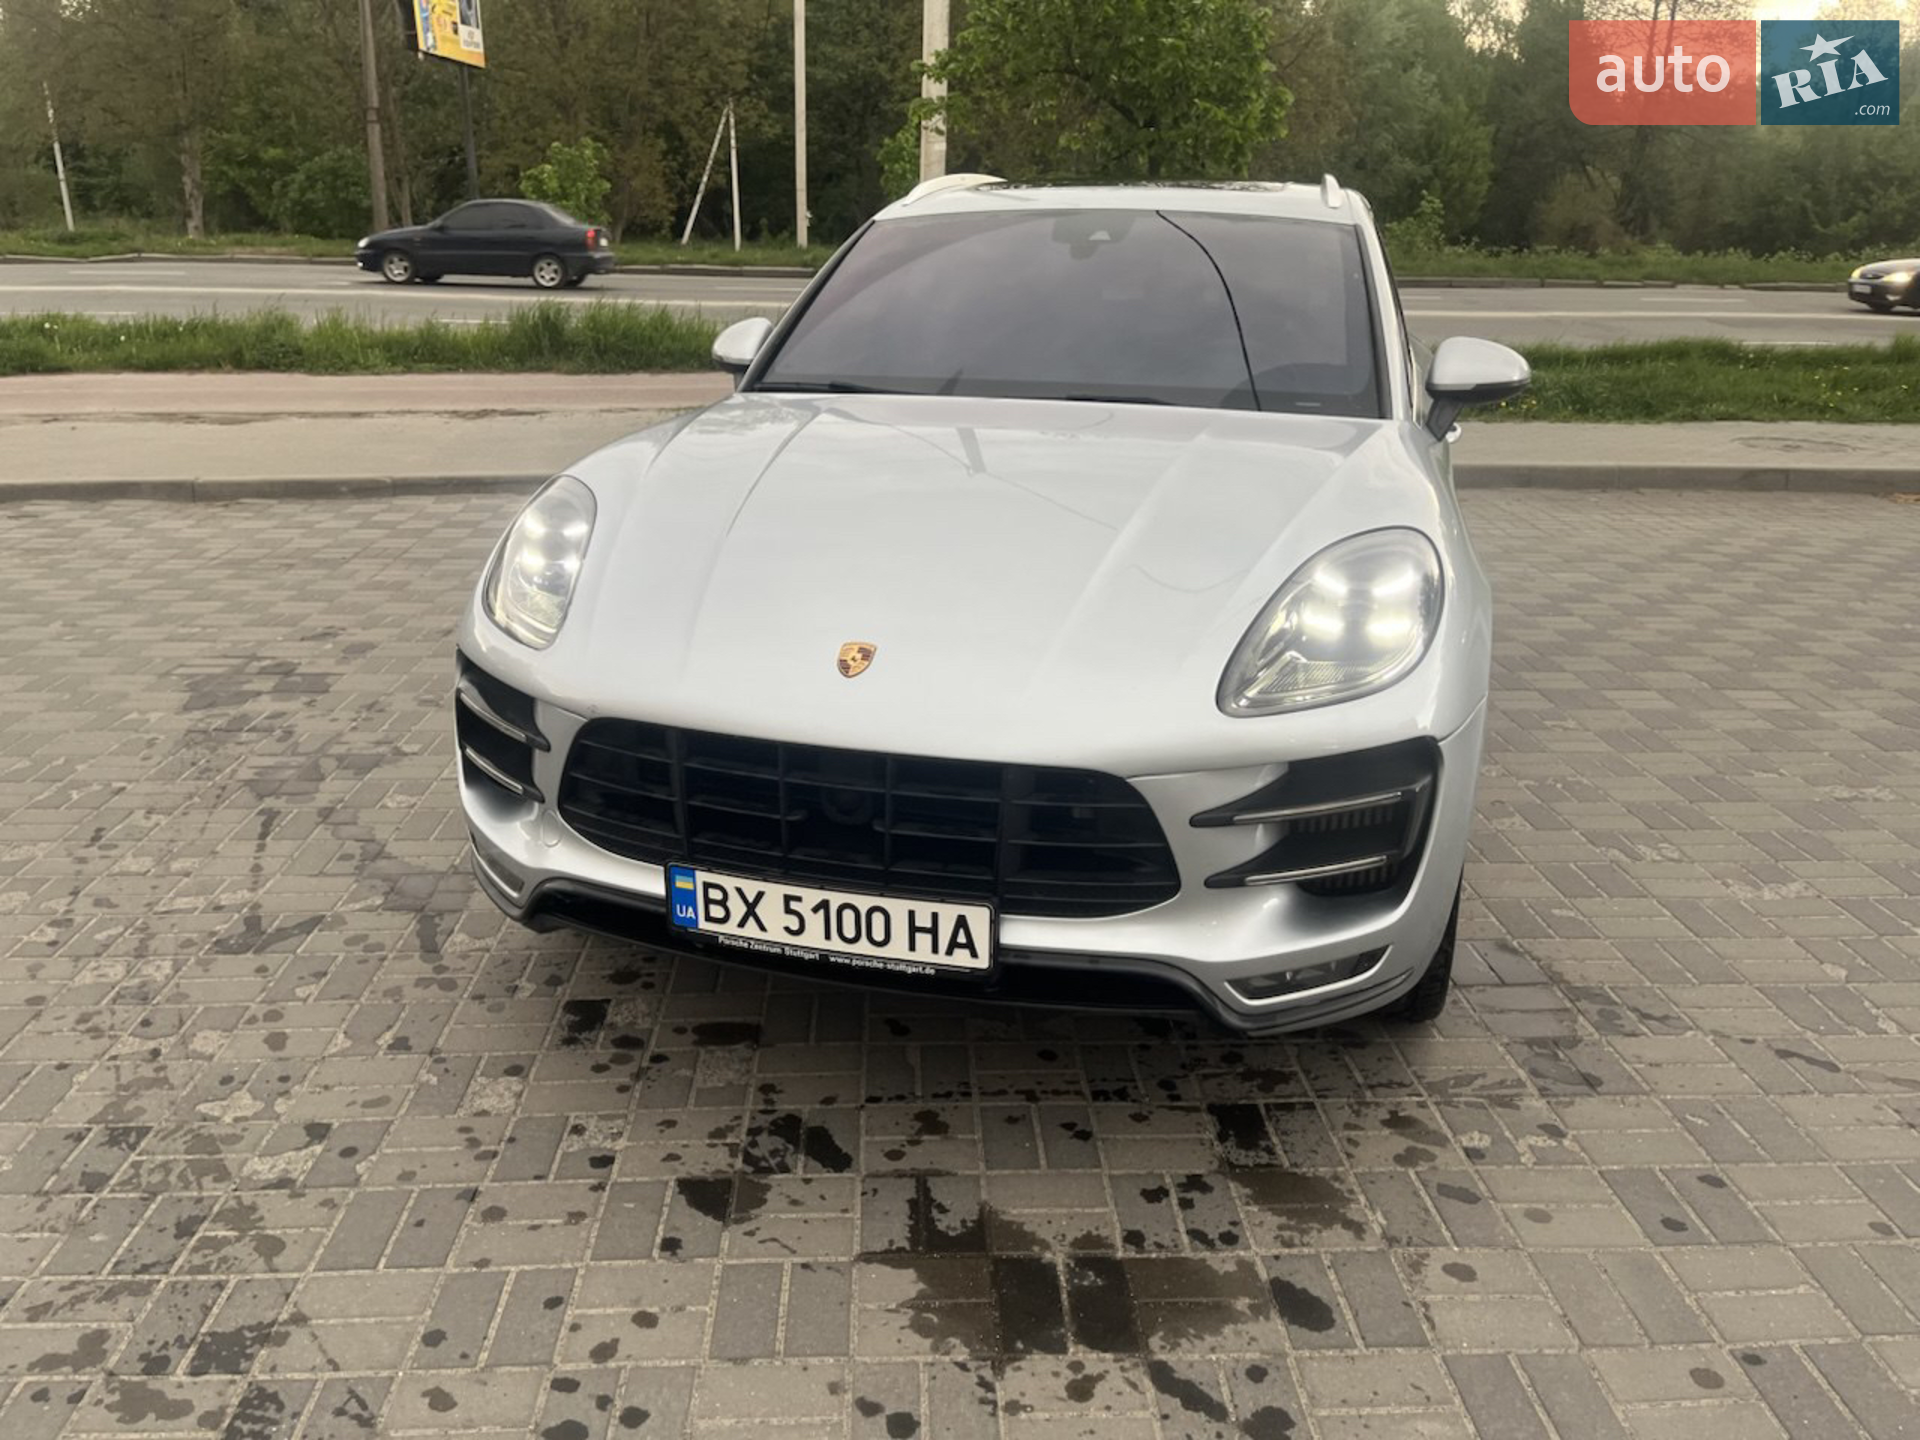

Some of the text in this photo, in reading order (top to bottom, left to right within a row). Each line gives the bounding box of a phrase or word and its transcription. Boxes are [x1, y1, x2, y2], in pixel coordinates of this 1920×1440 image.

[676, 904, 697, 920] UA
[702, 880, 980, 960] BX 5100 HA
[718, 935, 749, 949] Porsche
[749, 941, 782, 955] Zentrum
[784, 946, 820, 961] Stuttgart
